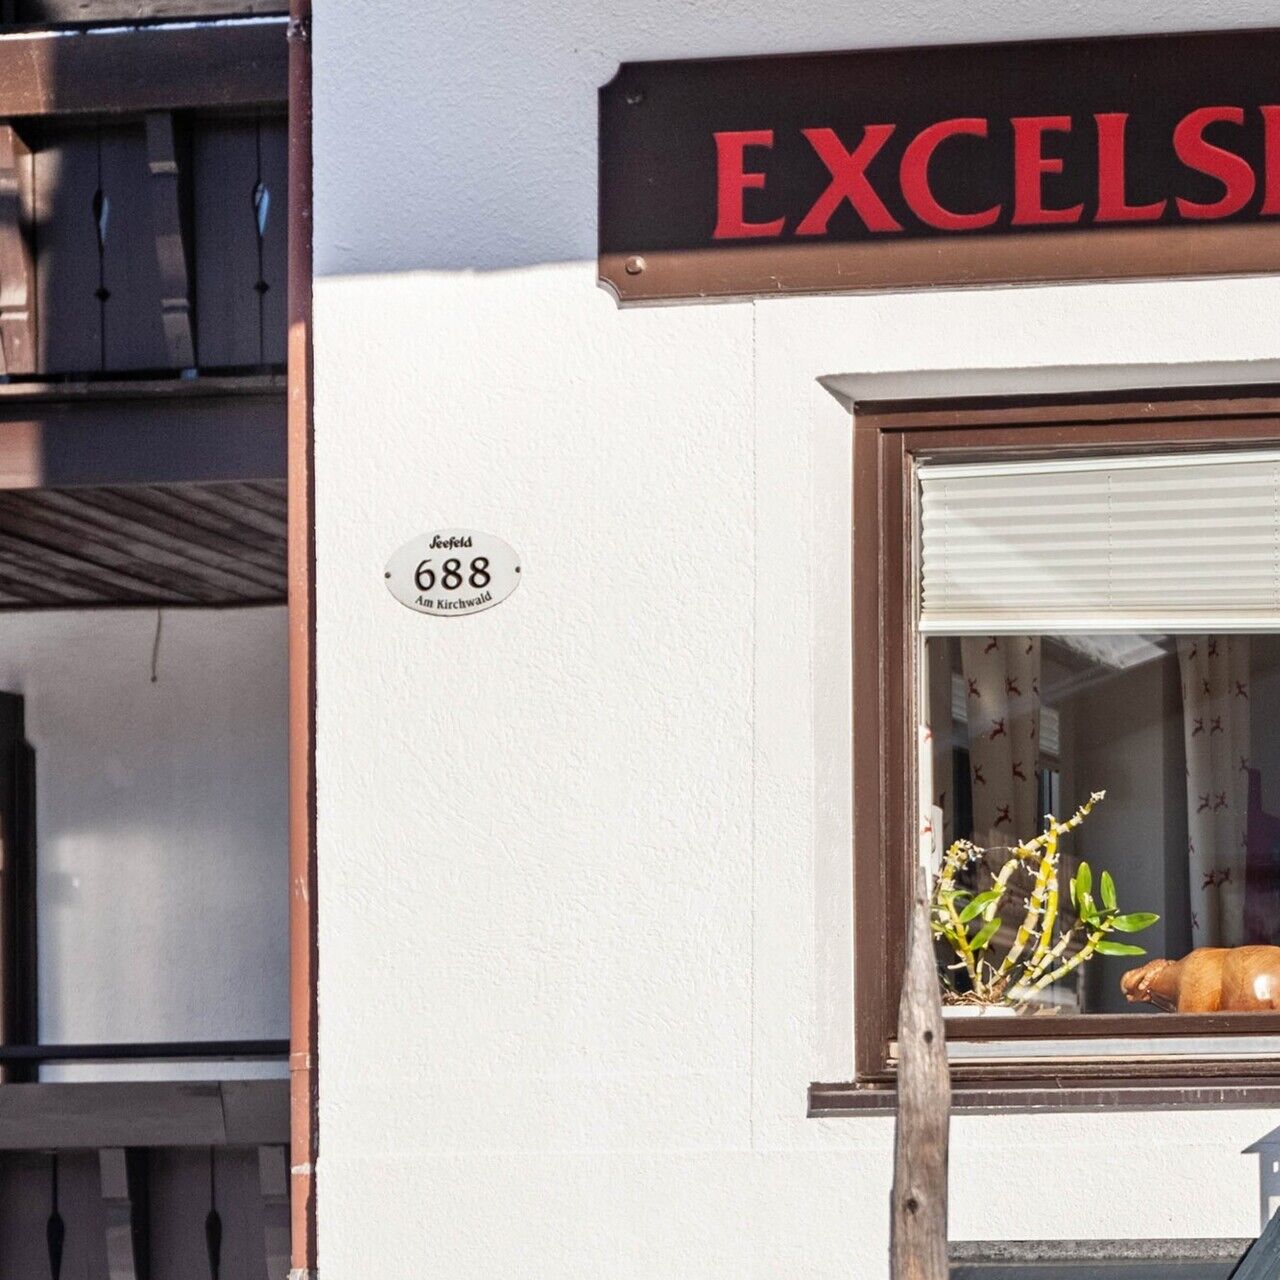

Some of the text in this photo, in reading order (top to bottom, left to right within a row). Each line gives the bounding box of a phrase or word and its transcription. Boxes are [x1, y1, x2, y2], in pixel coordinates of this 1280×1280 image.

[429, 534, 473, 550] Seefeld
[414, 556, 491, 591] 688
[415, 591, 493, 610] Am Kirchwald
